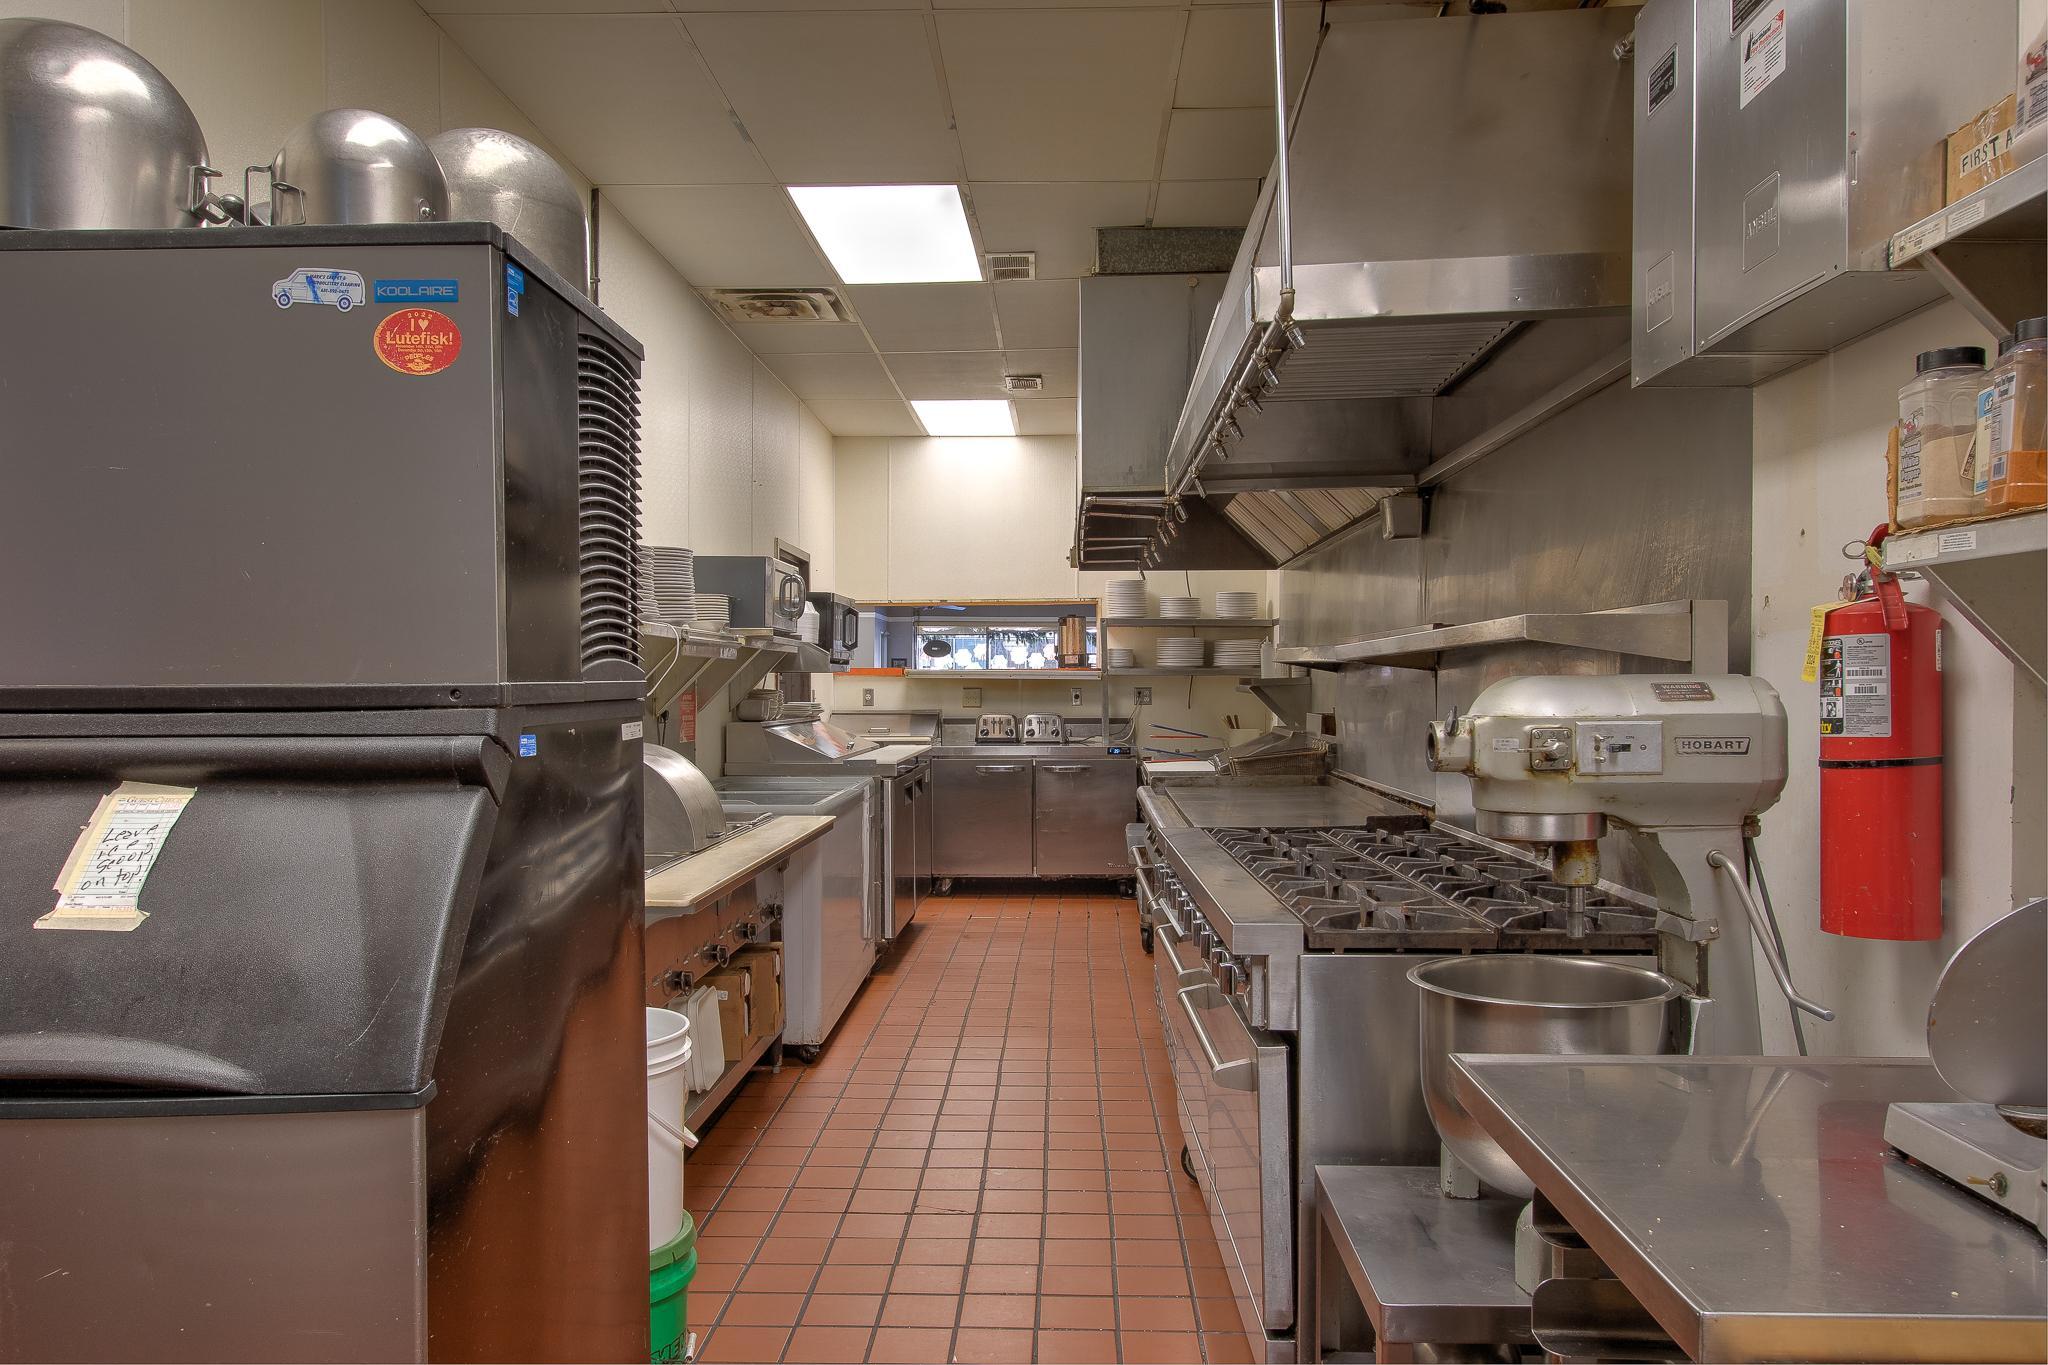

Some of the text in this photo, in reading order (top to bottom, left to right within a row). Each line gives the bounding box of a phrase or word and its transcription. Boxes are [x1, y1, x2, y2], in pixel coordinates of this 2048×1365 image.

[1962, 136, 1999, 173] FIRST
[377, 286, 454, 297] KOOLAIRE
[407, 311, 433, 320] 2022
[410, 319, 416, 331] I
[386, 331, 453, 345] Lutefisk!
[1682, 740, 1745, 753] HOBART
[81, 877, 105, 890] on
